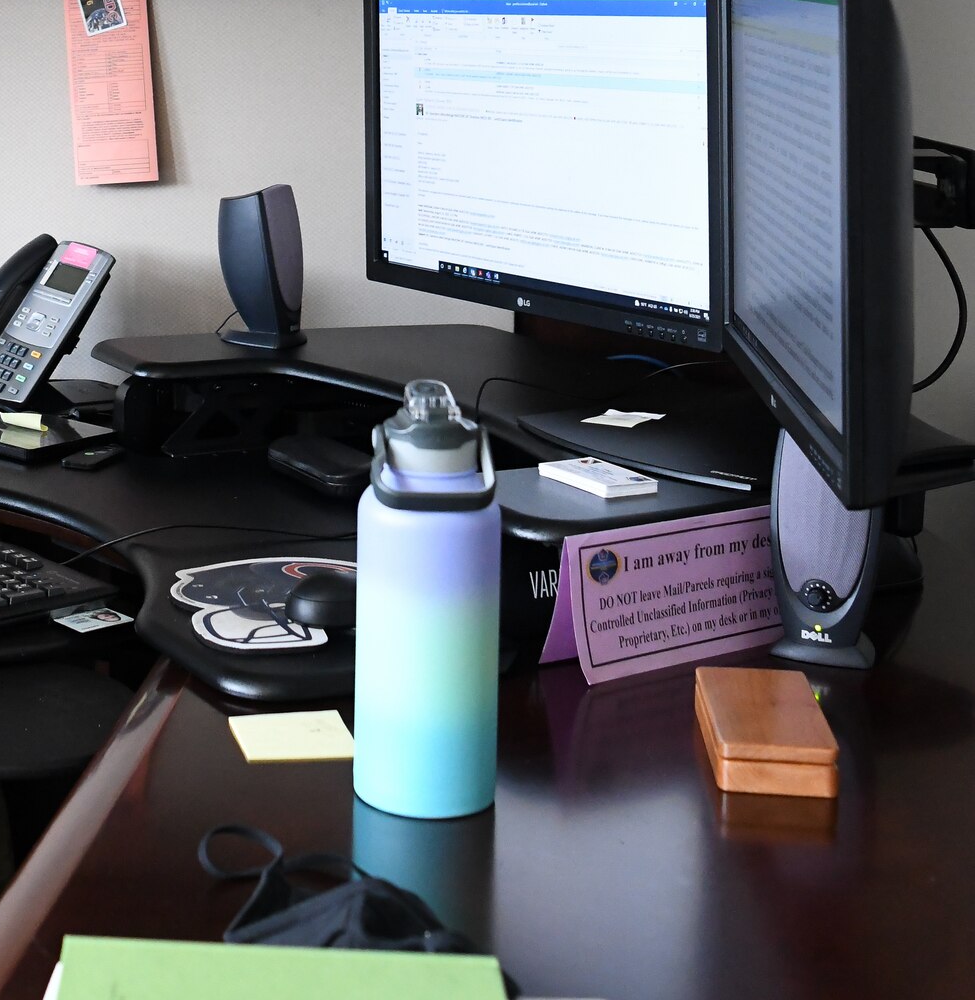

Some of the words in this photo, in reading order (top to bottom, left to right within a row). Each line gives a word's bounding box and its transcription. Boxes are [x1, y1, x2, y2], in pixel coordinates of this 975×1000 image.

[624, 556, 629, 572] I
[633, 557, 654, 571] am
[657, 550, 690, 566] away
[694, 543, 724, 559] from
[729, 539, 749, 554] my
[752, 533, 771, 549] des
[529, 569, 558, 599] VAR
[599, 596, 615, 611] DO
[616, 591, 638, 607] NOT
[640, 588, 661, 603] leave
[663, 577, 715, 599] Mail/Parcels
[716, 571, 755, 590] requiring
[756, 572, 761, 580] a
[763, 568, 774, 581] sig
[590, 614, 635, 634] Controlled
[637, 602, 686, 623] Unclassified
[688, 594, 737, 613] Information
[738, 586, 773, 605] (Privacy
[618, 628, 669, 649] Proprietary,
[671, 622, 691, 638] Etc.)
[692, 623, 703, 633] on
[704, 619, 718, 632] my
[719, 614, 738, 628] desk
[739, 612, 749, 622] or
[749, 609, 758, 621] in
[759, 607, 773, 620] my
[801, 629, 832, 643] DELL
